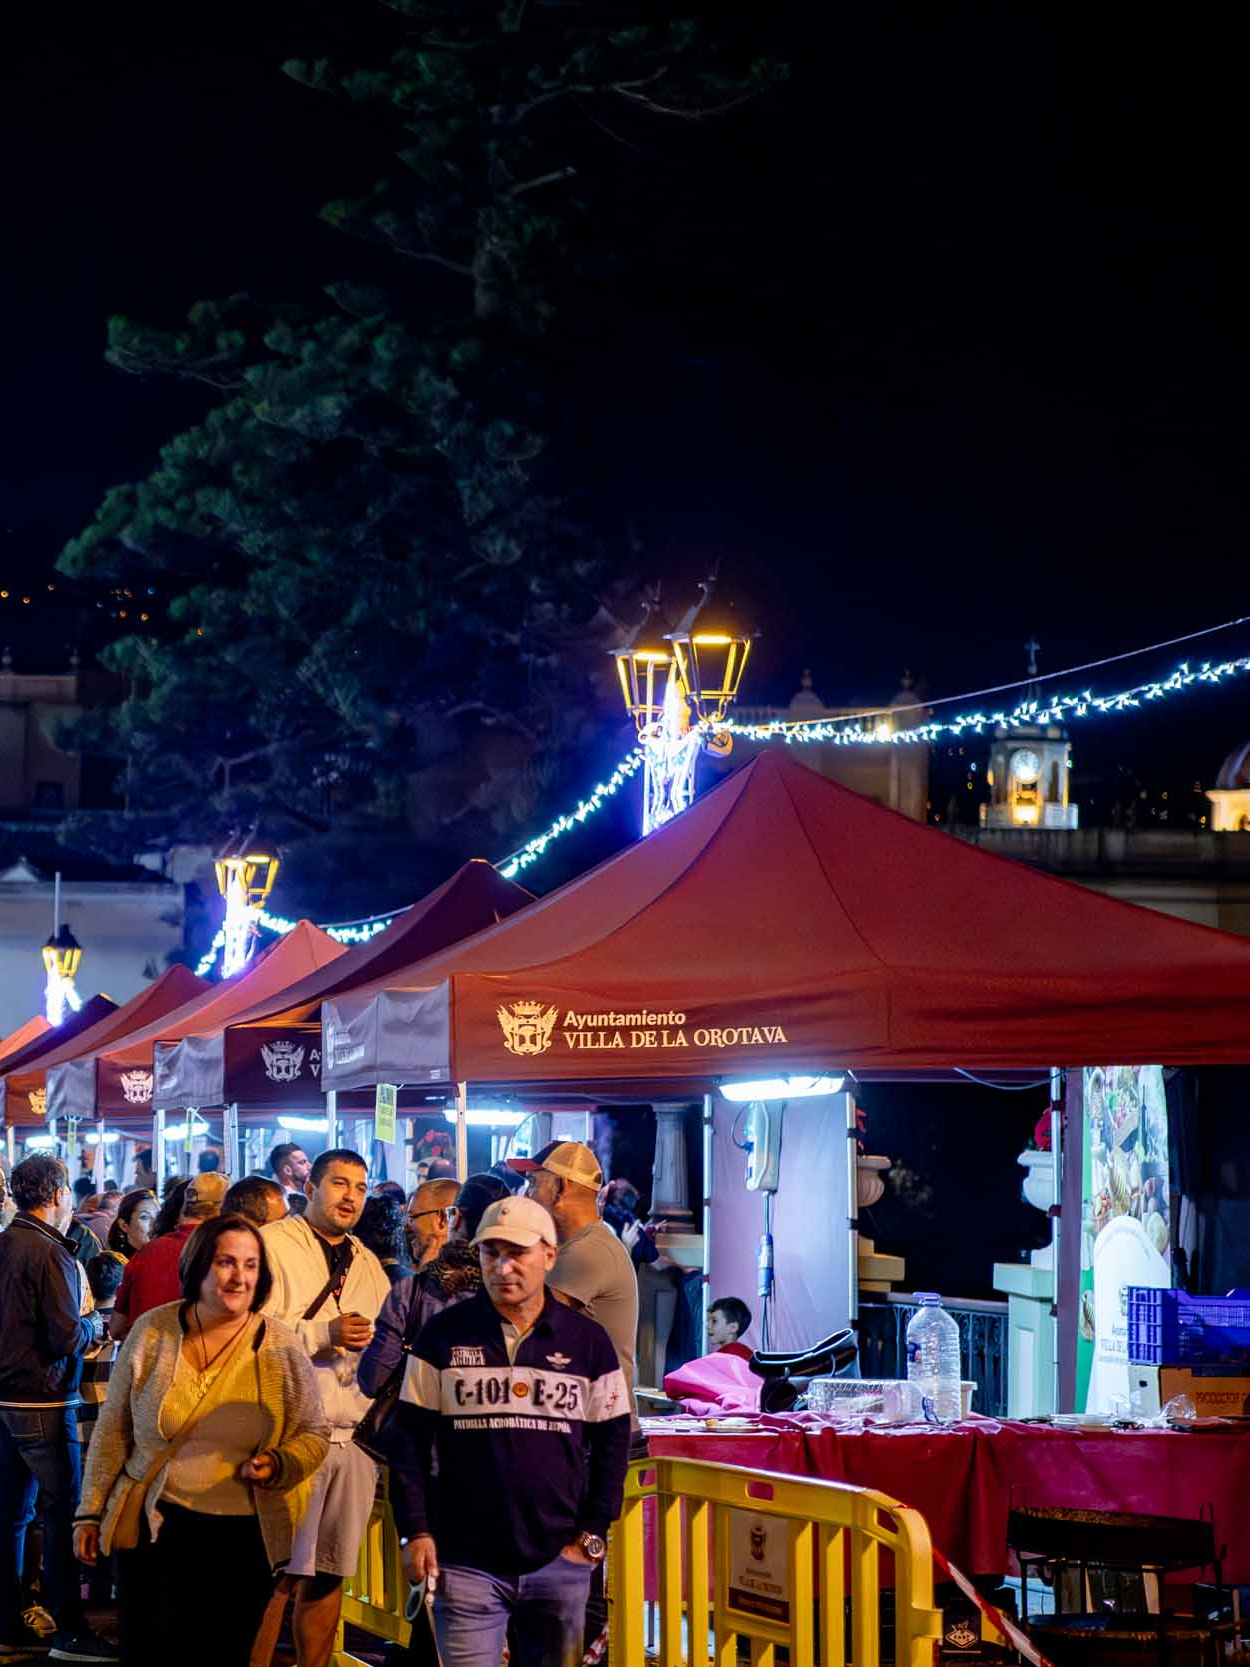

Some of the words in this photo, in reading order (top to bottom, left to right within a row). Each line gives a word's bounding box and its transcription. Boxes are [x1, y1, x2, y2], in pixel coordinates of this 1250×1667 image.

[563, 1010, 686, 1029] Ayuntamiento
[563, 1031, 625, 1049] VILLA
[630, 1031, 658, 1048] DE
[661, 1030, 689, 1047] LA
[693, 1026, 788, 1047] OROTAVA
[454, 1377, 510, 1407] C-101
[532, 1378, 578, 1411] E-25
